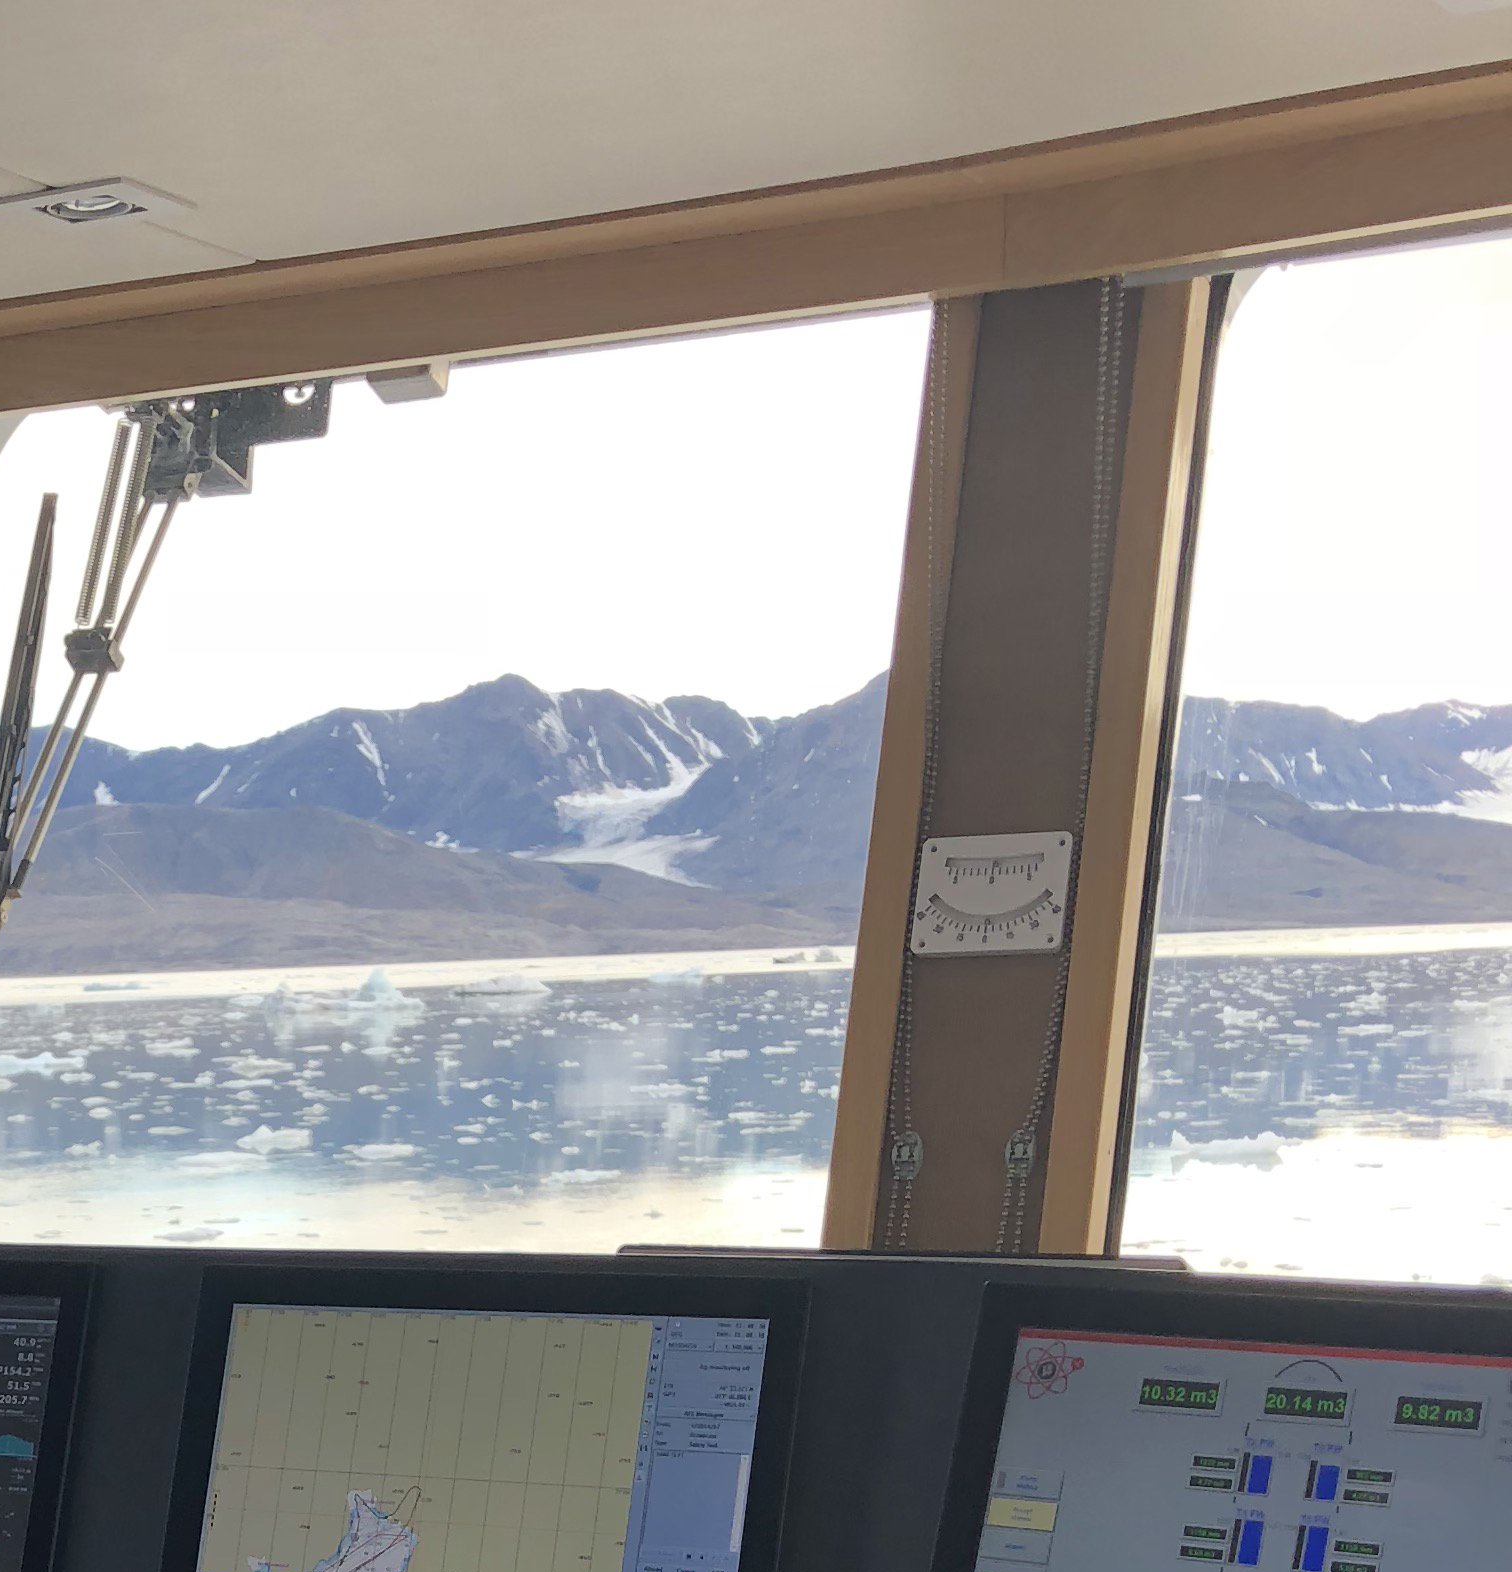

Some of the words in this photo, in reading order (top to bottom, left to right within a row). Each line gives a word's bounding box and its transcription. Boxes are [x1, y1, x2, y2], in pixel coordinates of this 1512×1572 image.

[7, 1380, 30, 1390] 51.5
[1142, 1384, 1185, 1401] 10.32
[1190, 1388, 1218, 1405] m3
[1265, 1392, 1312, 1411] 20.14
[1317, 1397, 1346, 1414] m3
[1401, 1404, 1439, 1421] 9.82
[1444, 1407, 1474, 1423] m3
